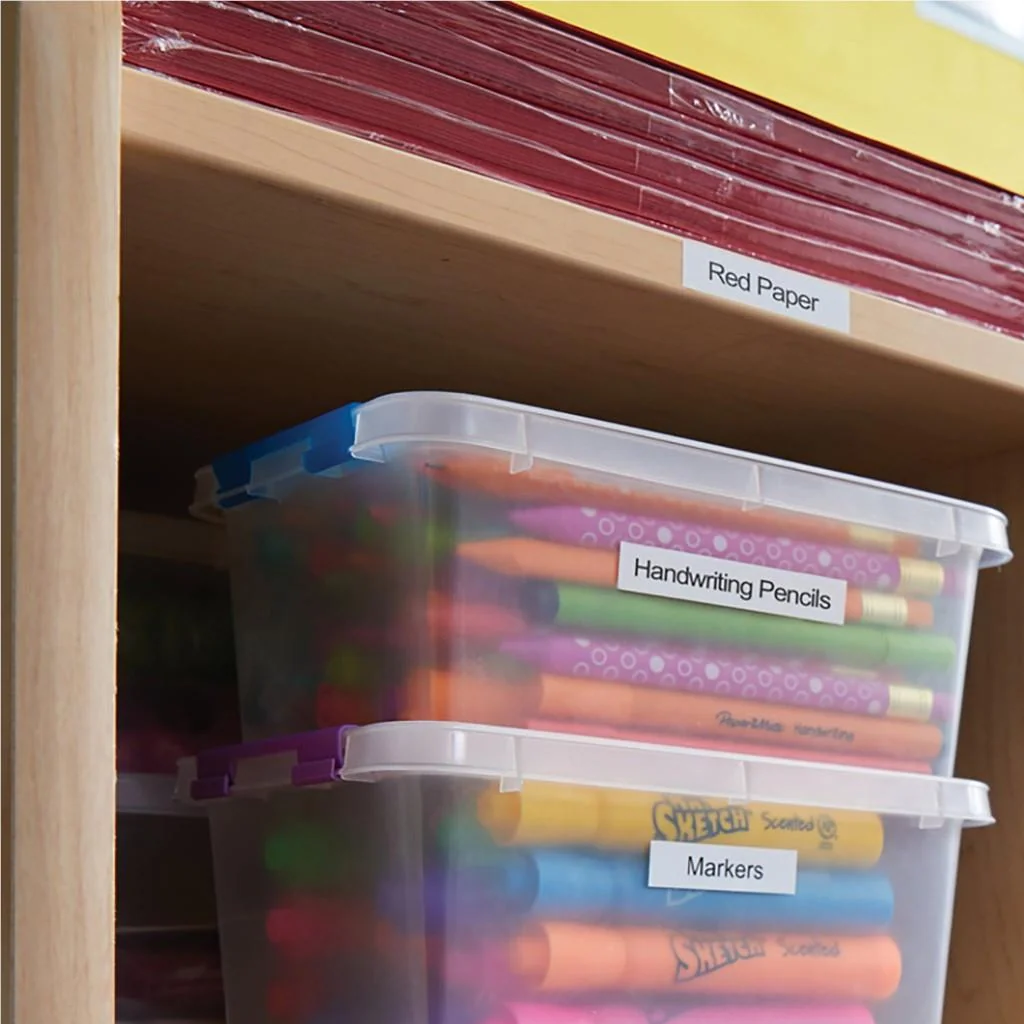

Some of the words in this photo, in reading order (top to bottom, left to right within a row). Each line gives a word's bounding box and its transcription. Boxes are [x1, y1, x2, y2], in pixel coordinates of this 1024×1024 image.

[709, 260, 751, 292] Red
[758, 276, 819, 311] Paper
[634, 558, 753, 601] Handwriting
[759, 579, 832, 610] Pencils
[652, 801, 751, 843] SKETCH
[760, 812, 814, 832] Scented
[687, 856, 764, 880] Markers
